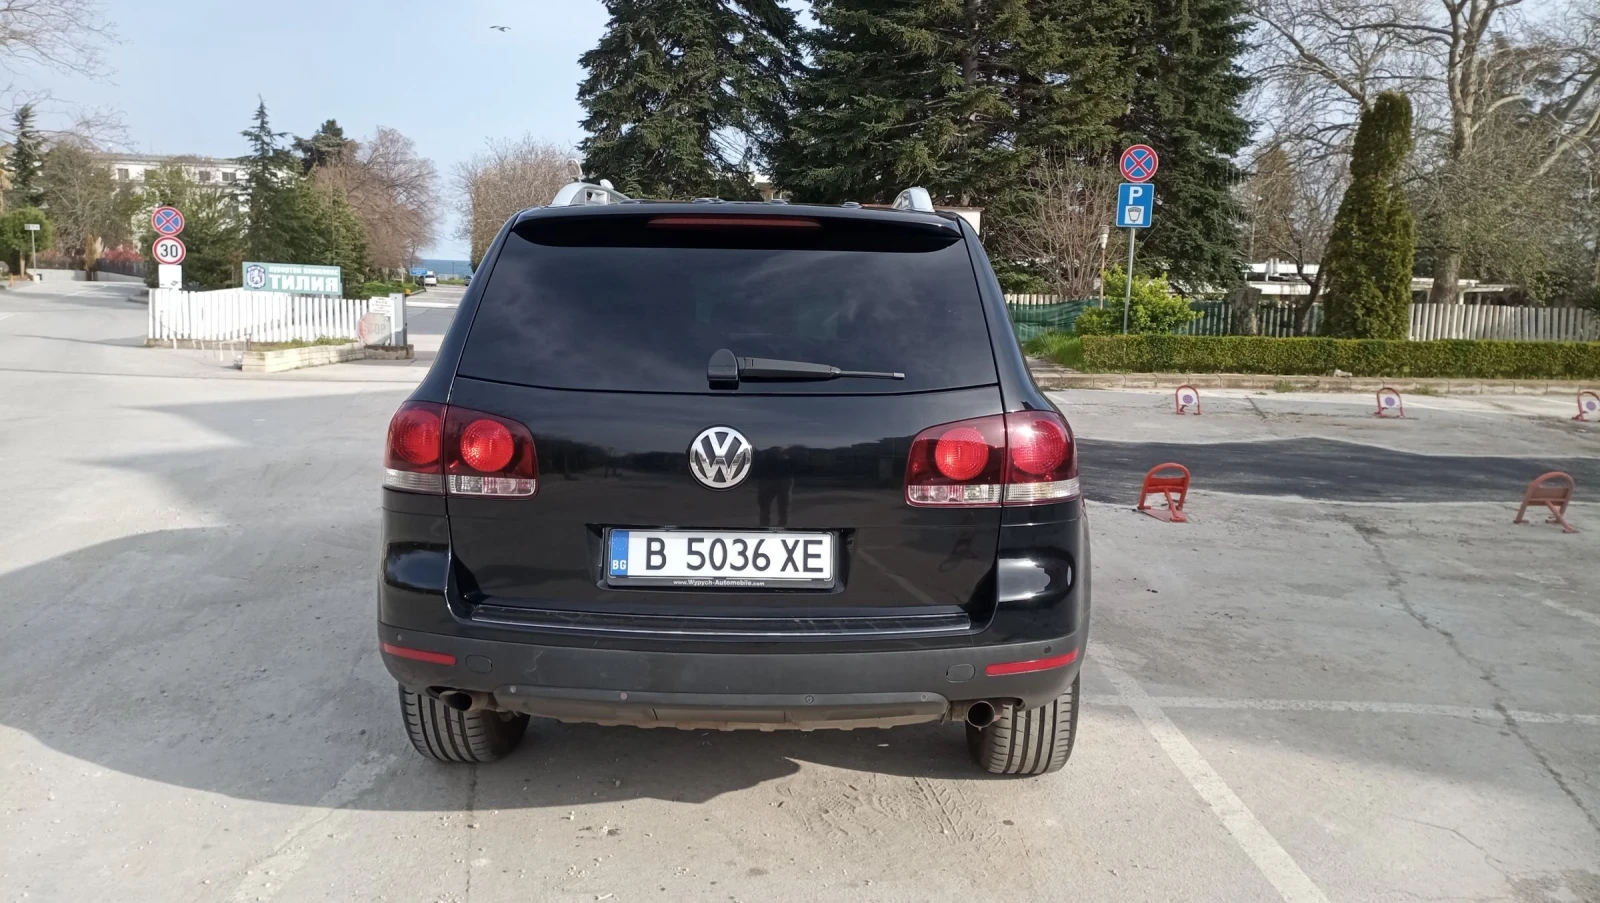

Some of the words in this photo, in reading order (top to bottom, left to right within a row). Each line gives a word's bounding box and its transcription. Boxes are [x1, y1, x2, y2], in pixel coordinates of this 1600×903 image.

[1129, 186, 1143, 205] P
[160, 244, 179, 258] 30
[268, 274, 339, 292] ТИЛИЯ
[645, 537, 667, 571] B
[686, 538, 771, 572] 5036
[780, 539, 824, 573] XE
[612, 560, 627, 570] BG
